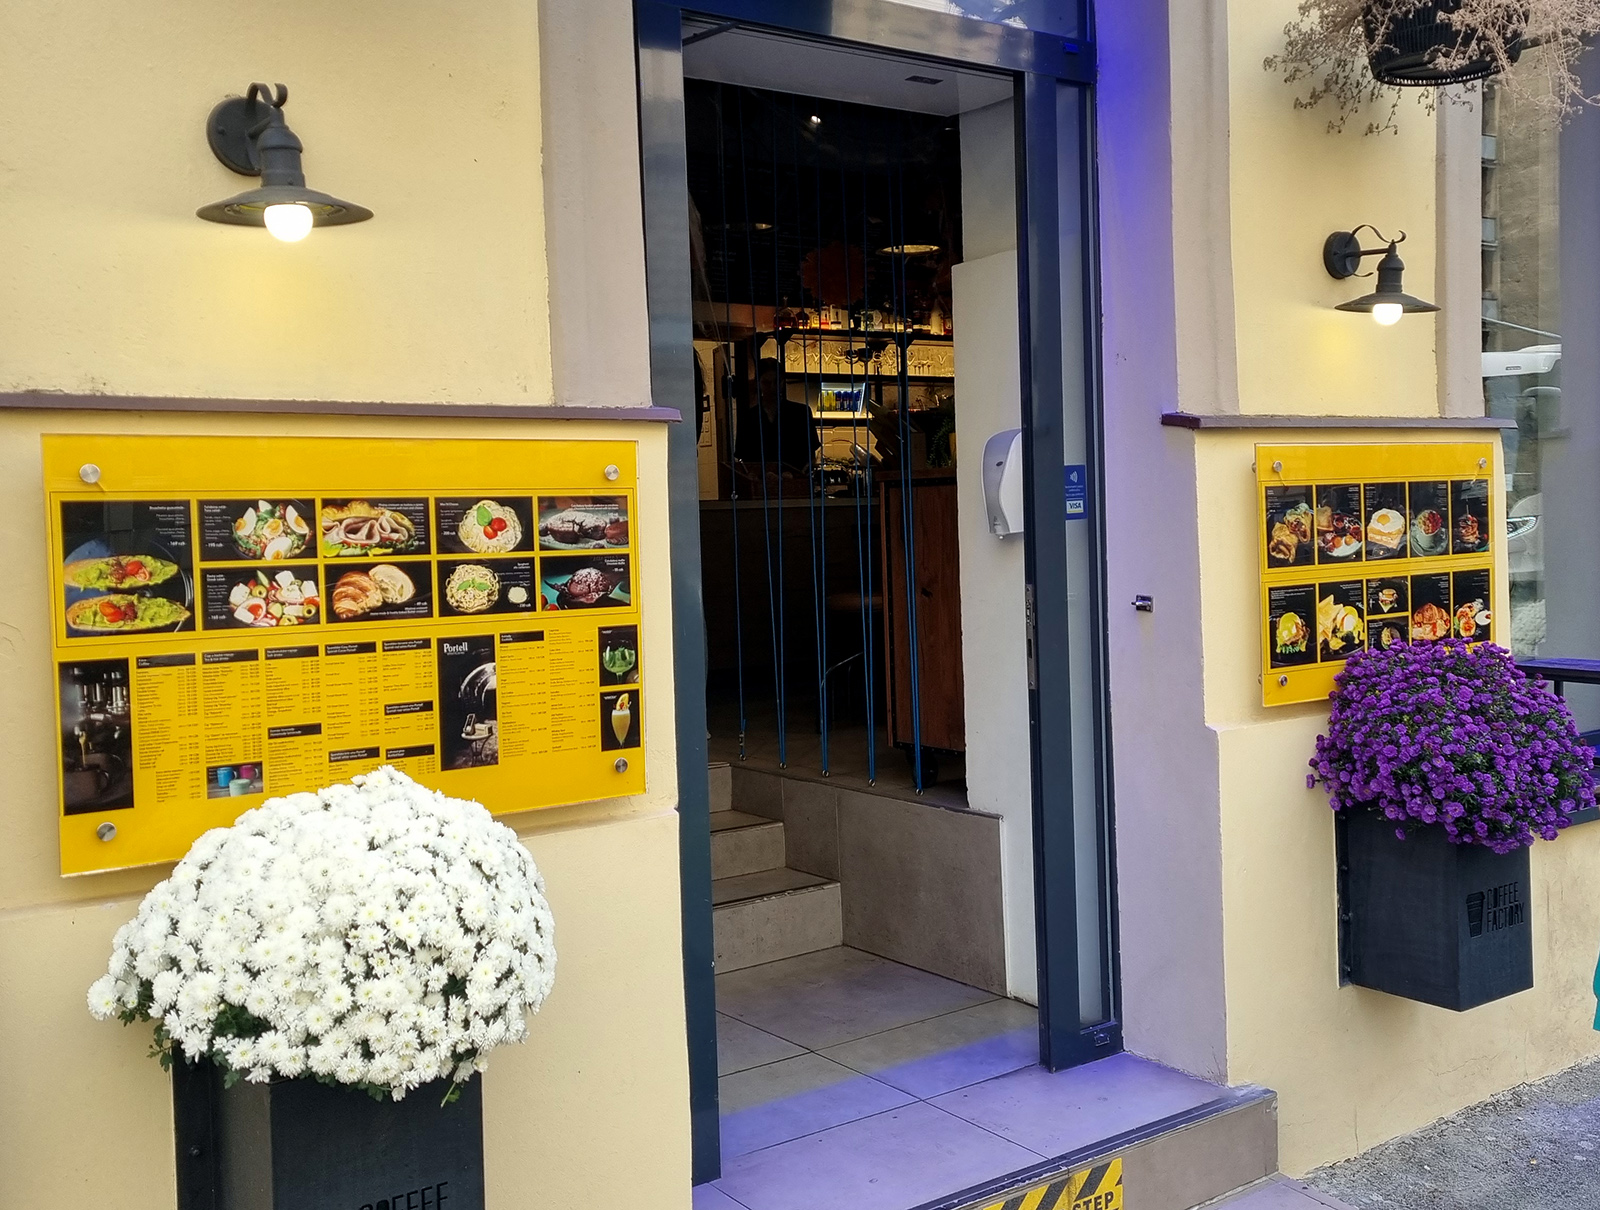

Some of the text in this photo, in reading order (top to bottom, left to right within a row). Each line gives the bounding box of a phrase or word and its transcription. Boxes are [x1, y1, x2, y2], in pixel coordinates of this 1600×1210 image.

[443, 642, 468, 653] Portell
[1487, 881, 1518, 910] COFFEE
[1486, 902, 1524, 932] FACTORY
